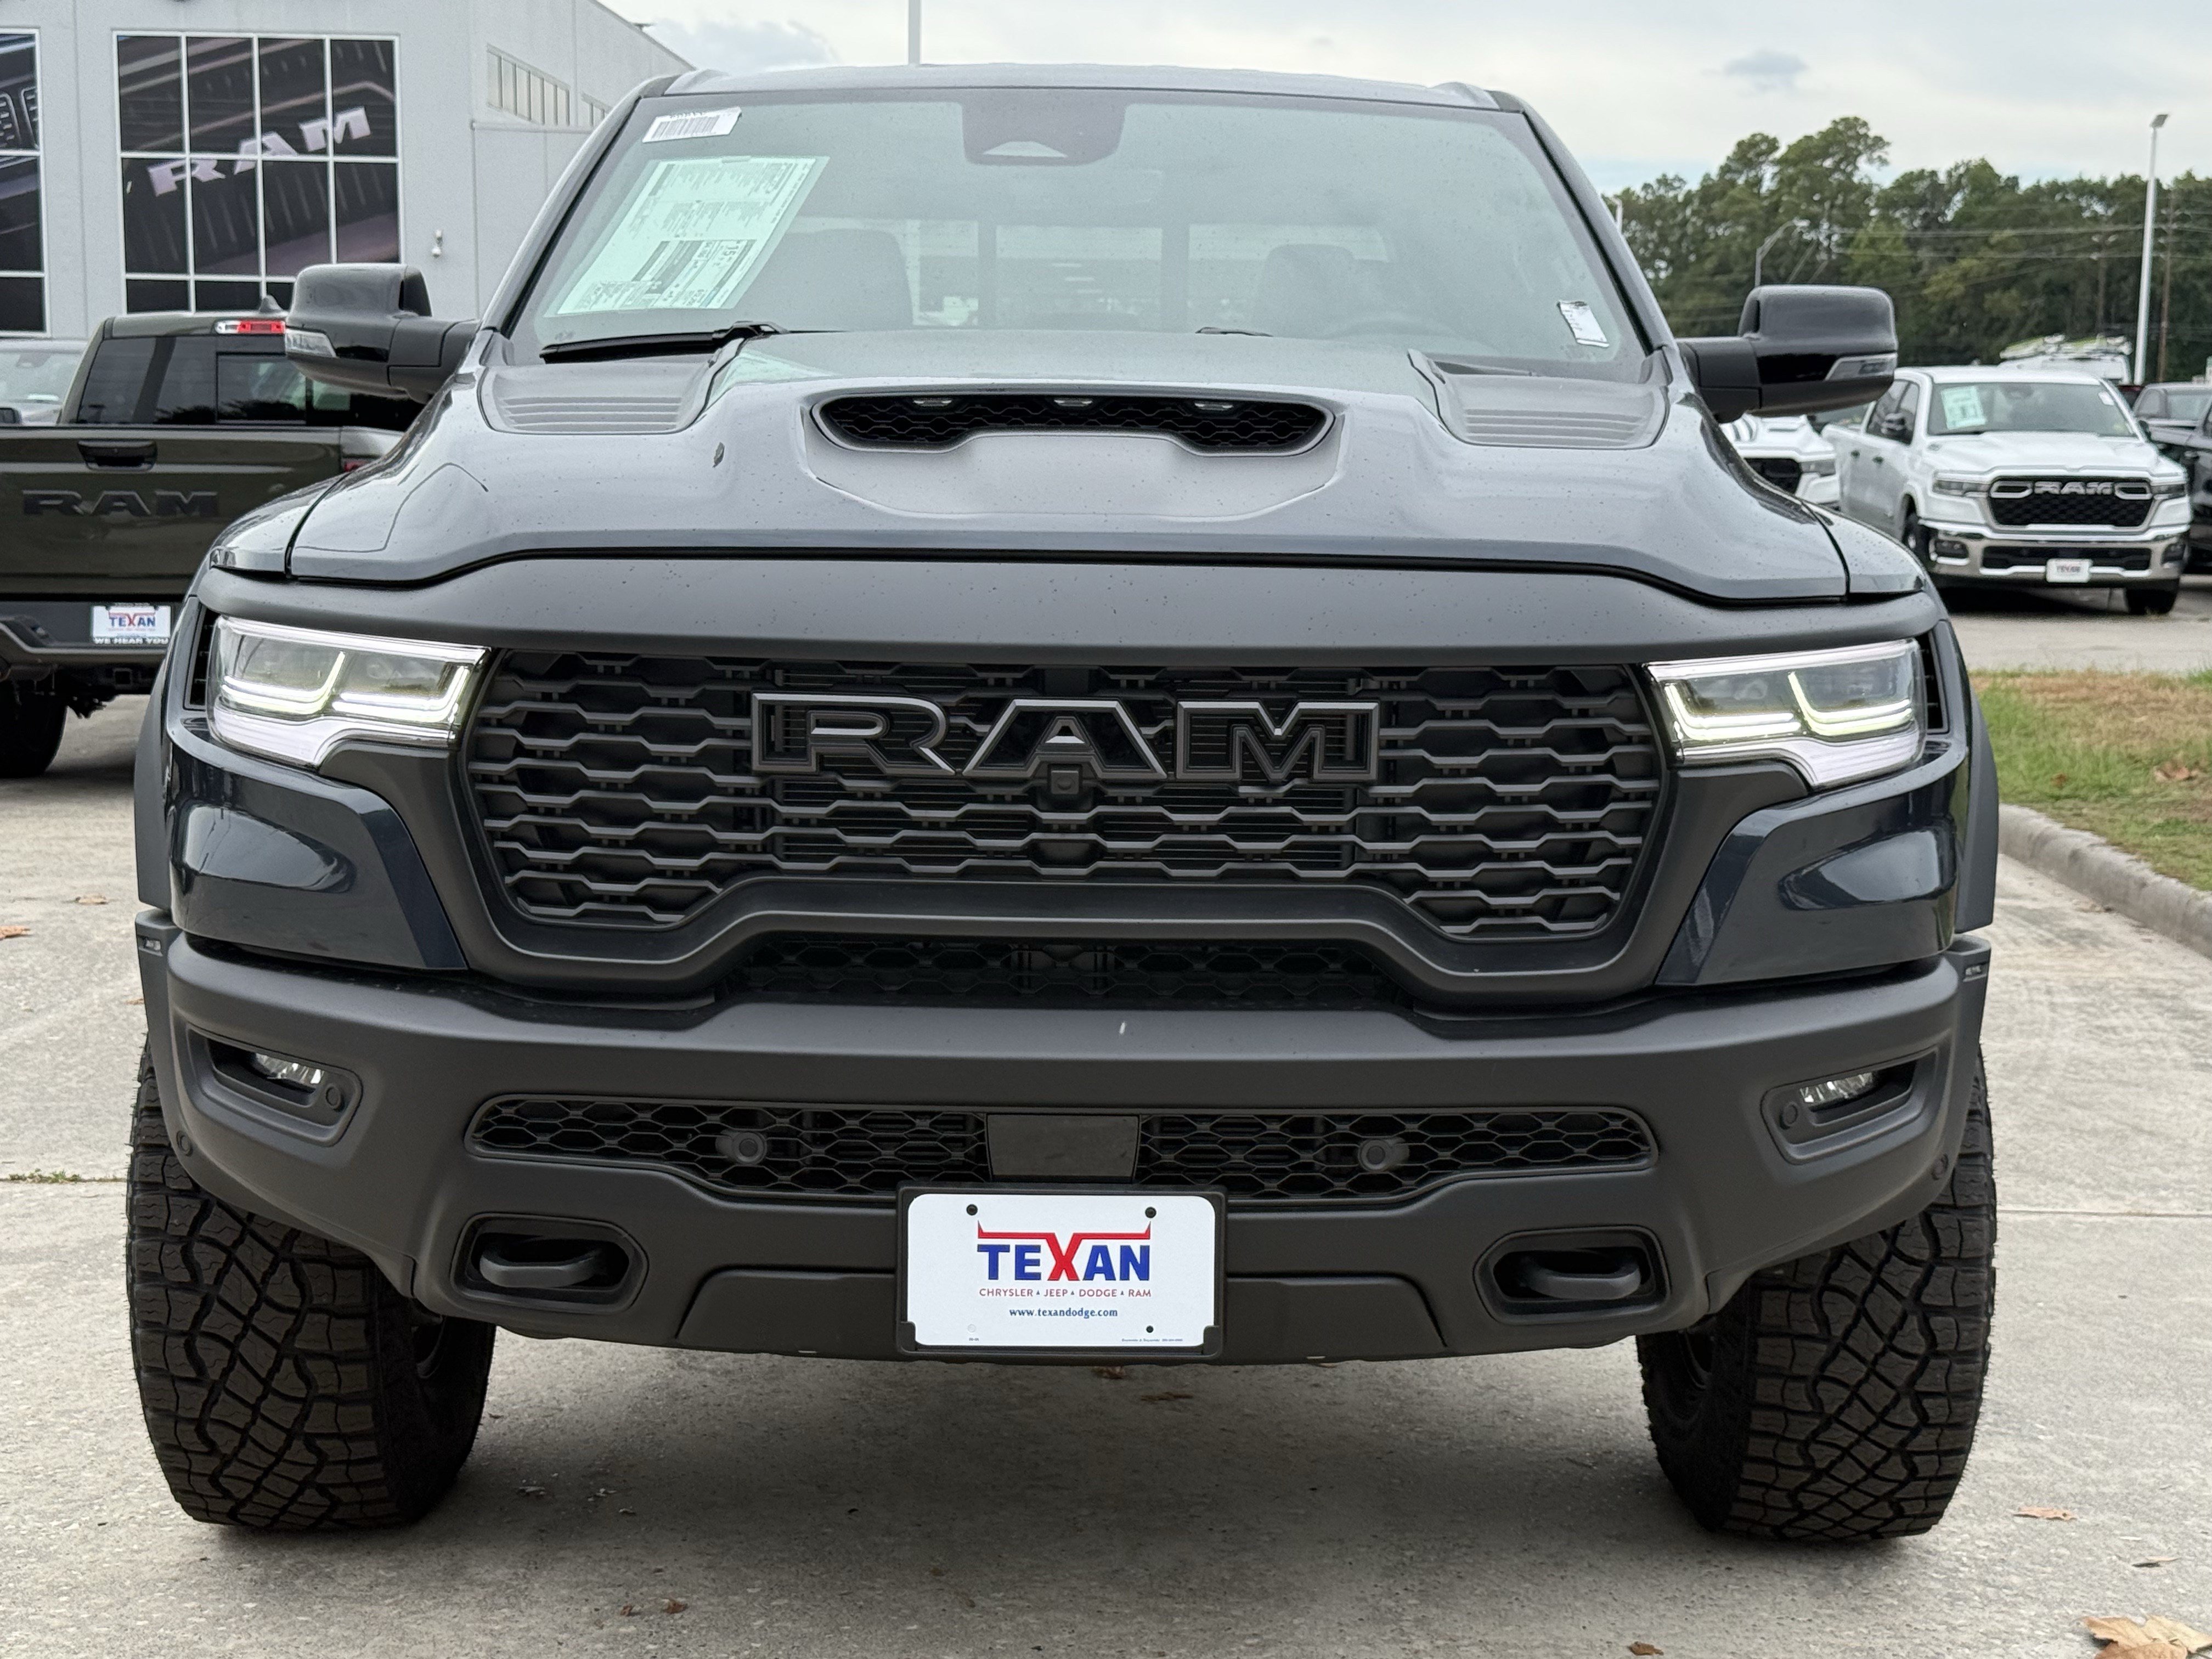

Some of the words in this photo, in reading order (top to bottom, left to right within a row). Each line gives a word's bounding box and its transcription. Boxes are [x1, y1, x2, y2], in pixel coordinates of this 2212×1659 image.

[147, 106, 371, 197] RAM
[2035, 481, 2113, 495] RAM
[22, 490, 218, 517] RAM
[109, 612, 155, 627] TEXAN
[751, 692, 1380, 781] RAM
[977, 1229, 1150, 1281] TEXAN
[979, 1288, 1034, 1297] CHRYSLER
[1043, 1288, 1068, 1297] JEEP
[1079, 1288, 1118, 1297] DODGE
[1009, 1307, 1118, 1319] www.texandodge.com
